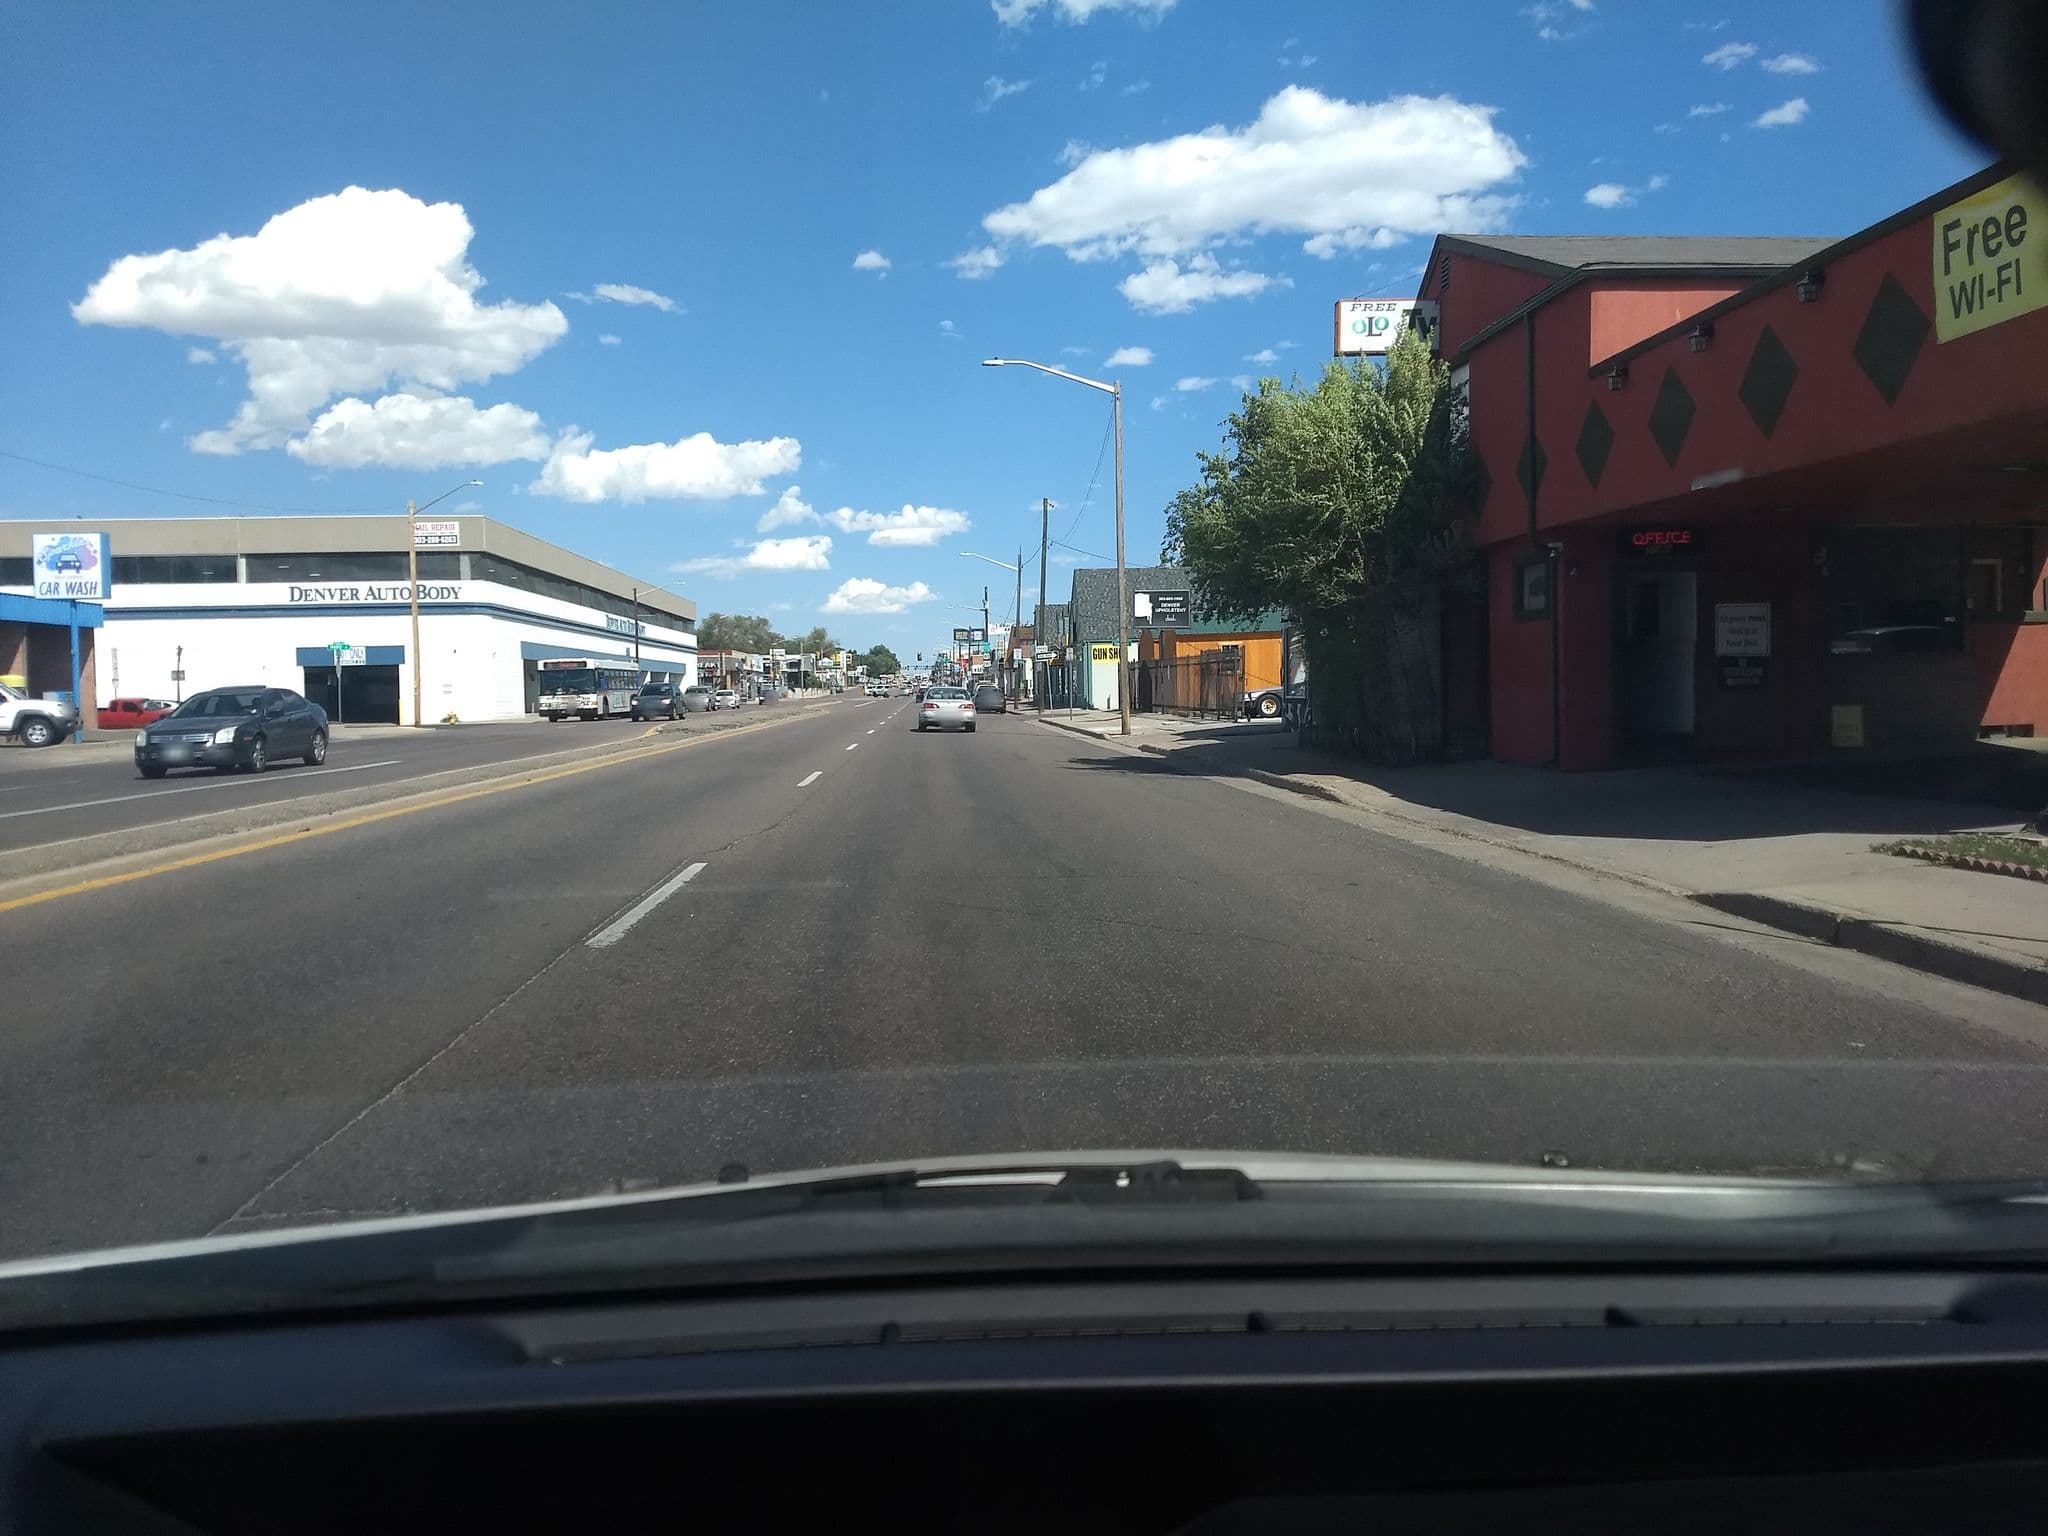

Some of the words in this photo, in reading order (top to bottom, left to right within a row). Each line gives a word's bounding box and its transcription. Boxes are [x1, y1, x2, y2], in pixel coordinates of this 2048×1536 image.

[1943, 205, 2027, 276] Free
[1950, 258, 2022, 319] WI-FI
[1350, 303, 1397, 312] FREE
[39, 582, 60, 596] CAR
[65, 581, 98, 596] WASH
[289, 586, 360, 602] DENVER
[364, 585, 412, 600] AUTO
[416, 584, 462, 600] BODY
[1092, 648, 1108, 660] GUN
